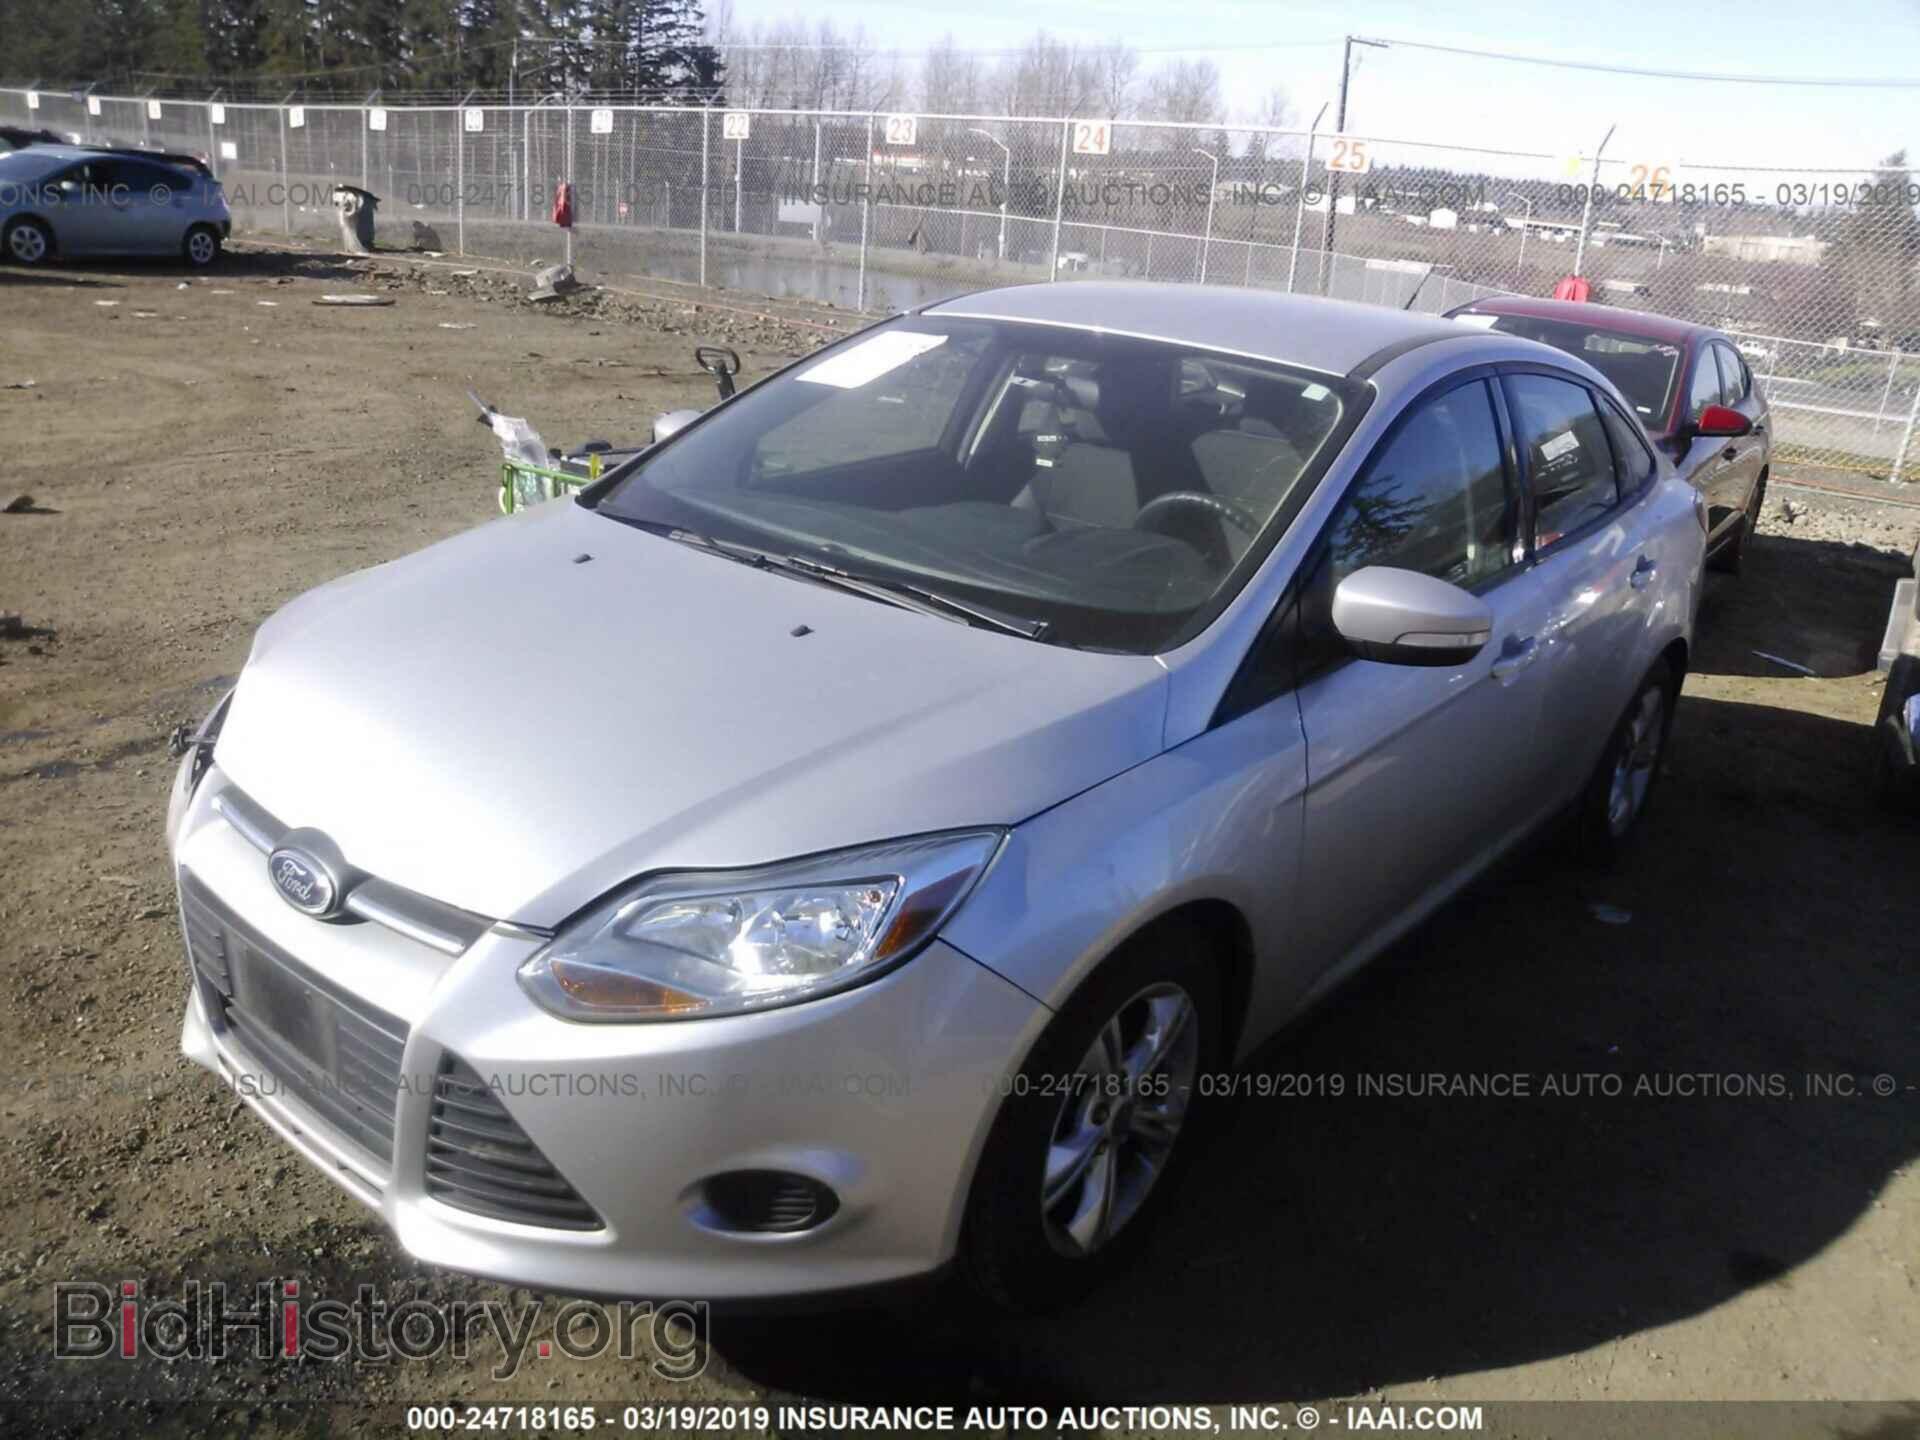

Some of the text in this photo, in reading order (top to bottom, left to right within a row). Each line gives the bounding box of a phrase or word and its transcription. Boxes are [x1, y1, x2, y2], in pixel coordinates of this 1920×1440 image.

[889, 118, 912, 142] 23
[1078, 126, 1105, 150] 24
[1331, 139, 1365, 170] 25
[1631, 164, 1672, 197] 26
[276, 859, 312, 901] Ford
